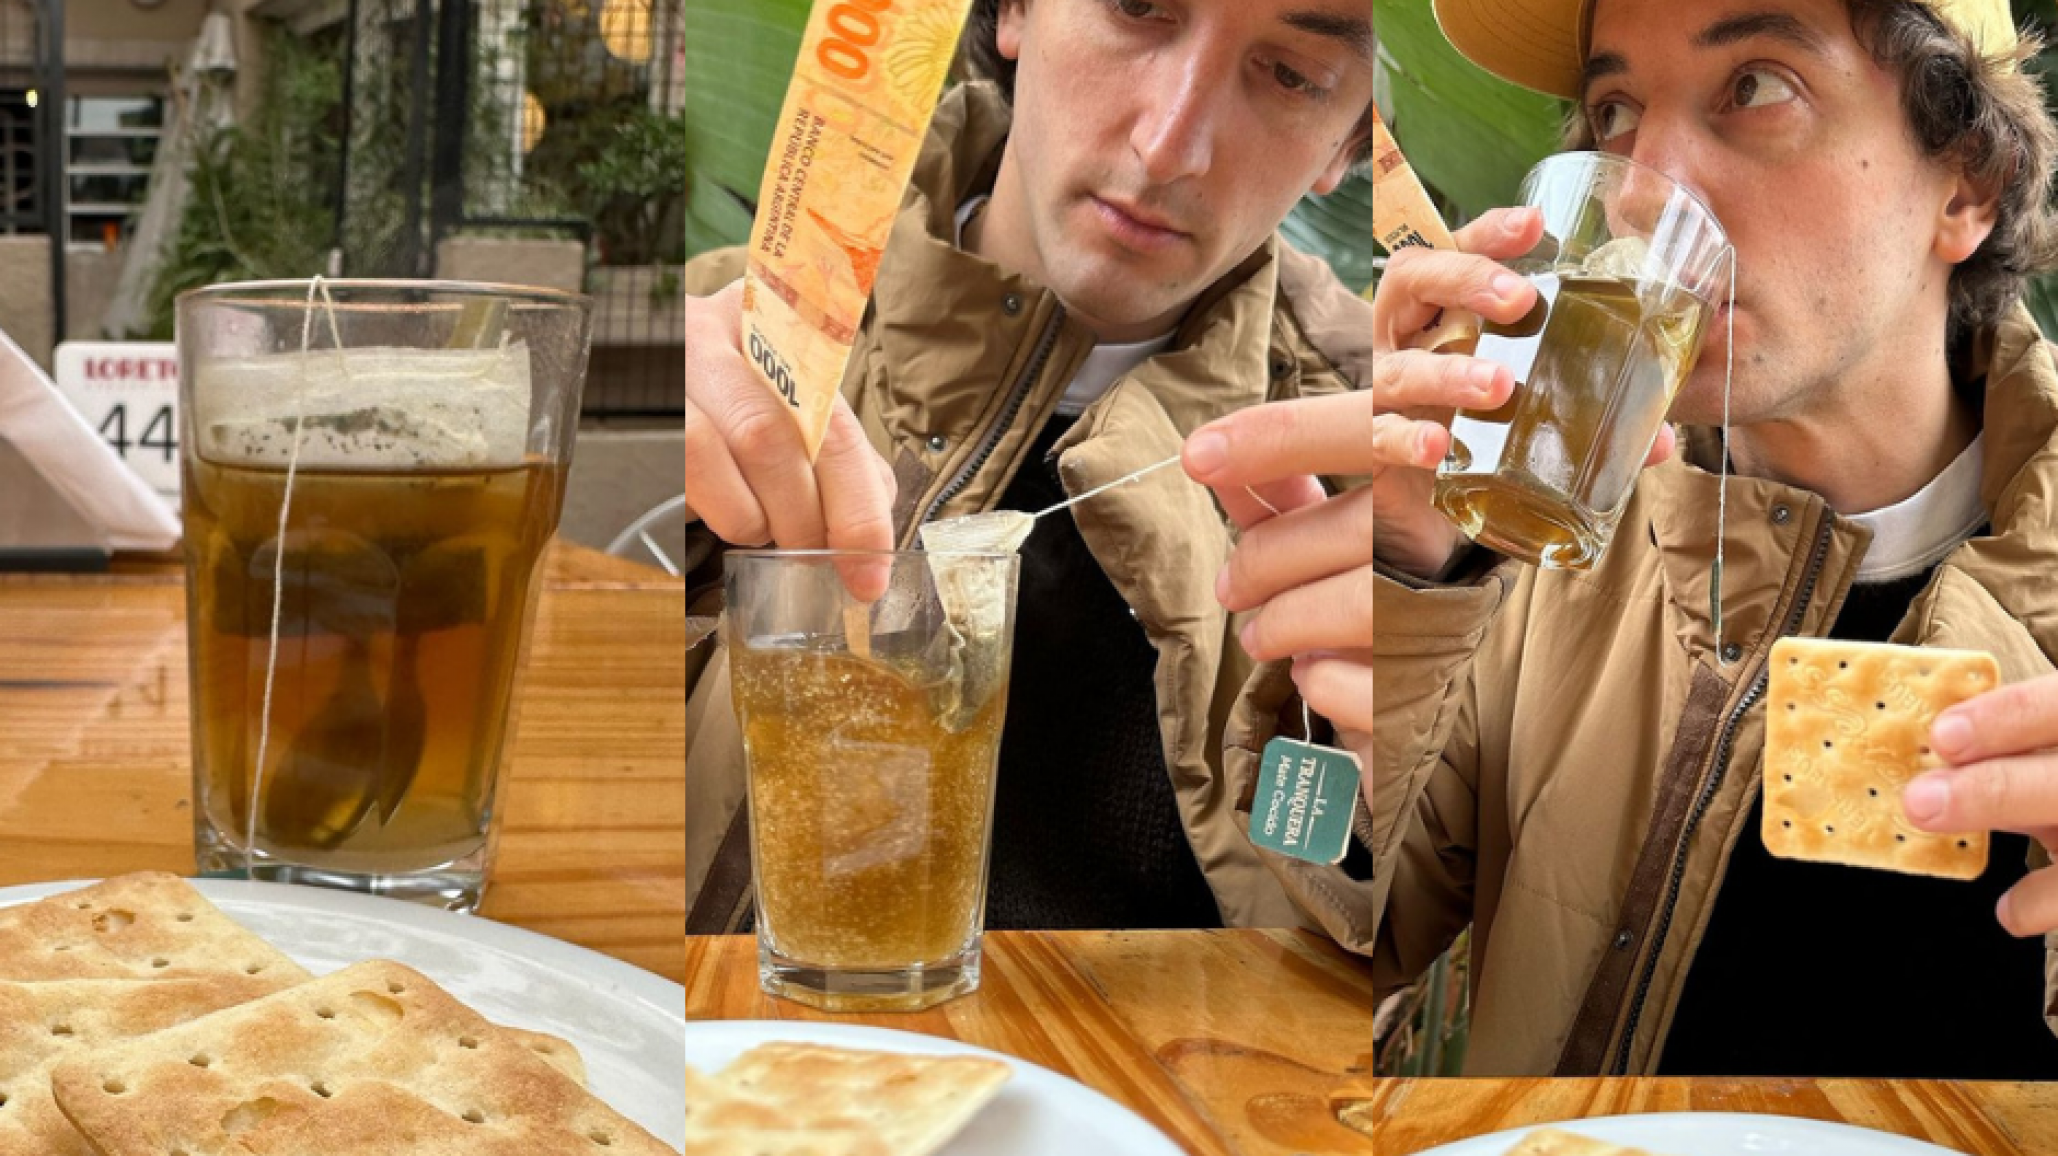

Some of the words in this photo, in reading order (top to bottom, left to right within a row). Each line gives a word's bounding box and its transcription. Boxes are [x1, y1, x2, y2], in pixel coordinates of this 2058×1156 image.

[817, 0, 893, 79] 00
[800, 116, 825, 166] BANCO
[760, 184, 786, 252] ARGENTINA
[784, 168, 808, 221] CENTRAL
[773, 242, 786, 258] LA
[780, 223, 793, 242] DE
[750, 332, 800, 408] 1000
[98, 403, 180, 463] 44
[1276, 755, 1292, 787] Mate
[1263, 790, 1285, 836] Cocido
[1283, 757, 1316, 845] TRANQUERA
[1311, 798, 1327, 815] LA
